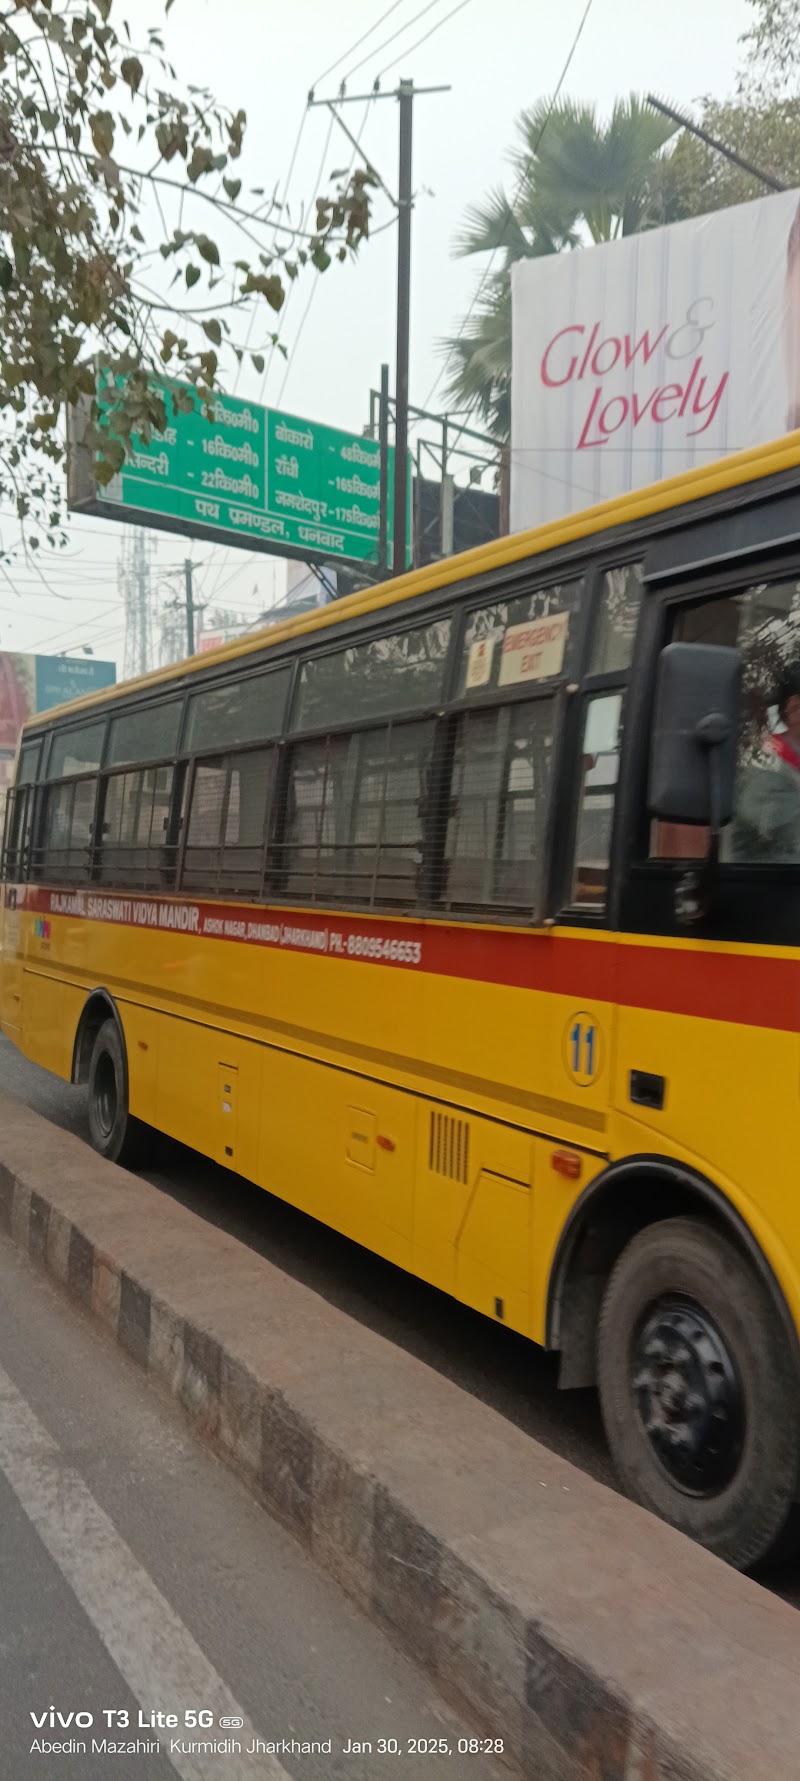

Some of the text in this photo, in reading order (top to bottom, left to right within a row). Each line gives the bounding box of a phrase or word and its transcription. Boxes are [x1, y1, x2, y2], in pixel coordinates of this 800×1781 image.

[540, 321, 669, 388] Glow
[577, 355, 729, 449] Lovely
[195, 500, 220, 519] पथ
[88, 897, 130, 921] SARASWATI
[133, 902, 157, 925] VIDYA
[203, 917, 223, 934] ASHOK
[572, 1023, 595, 1075] 11
